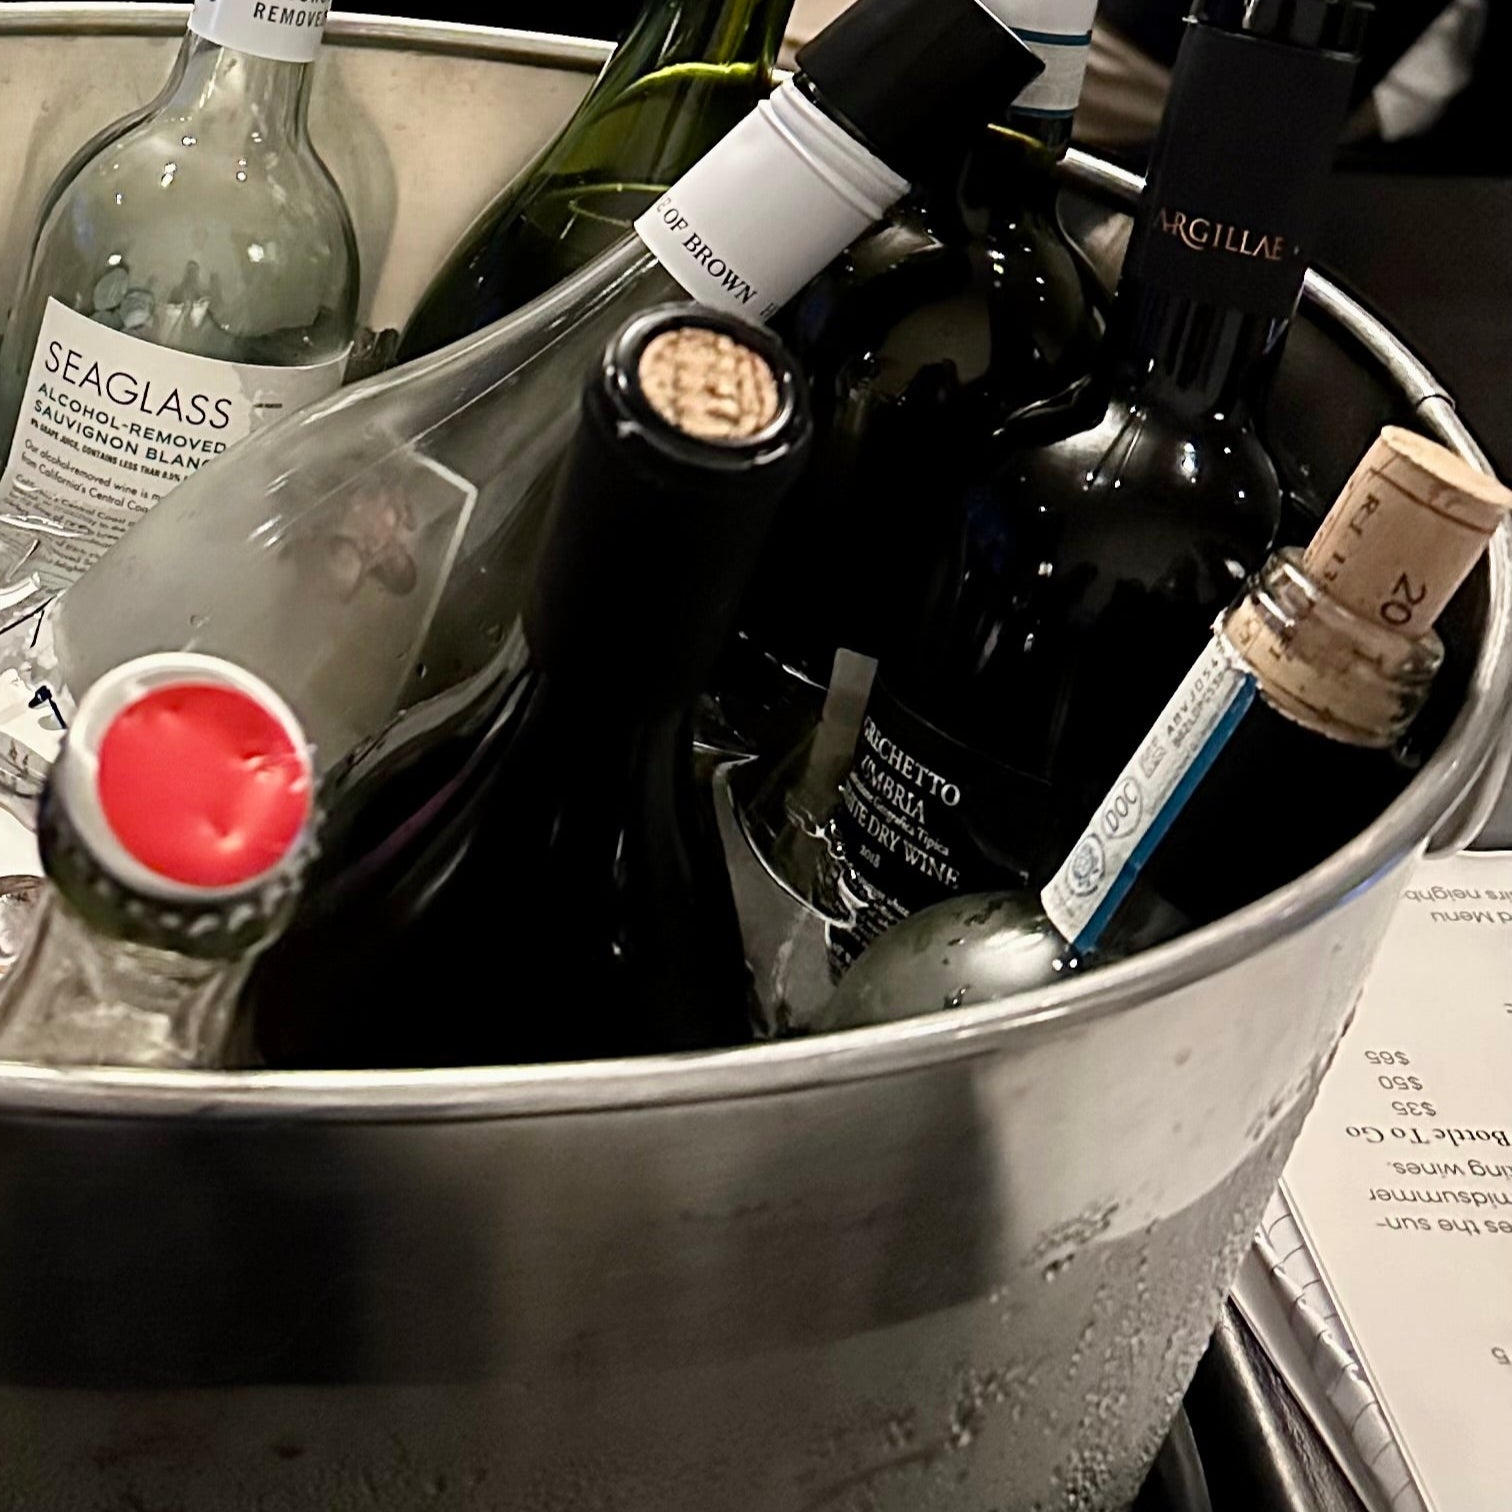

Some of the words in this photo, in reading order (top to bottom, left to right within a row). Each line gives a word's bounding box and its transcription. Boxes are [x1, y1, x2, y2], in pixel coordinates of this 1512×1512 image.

[663, 208, 689, 231] OF
[682, 232, 757, 304] BROWN
[44, 340, 233, 430] SEAGLASS
[34, 399, 138, 456] SAUVIGNON
[38, 382, 227, 455] ALCOHOL-REMOVED
[119, 459, 139, 472] LESS
[140, 465, 161, 478] THAN
[38, 463, 87, 494] California's
[89, 487, 125, 507] Central
[113, 481, 138, 496] wine
[140, 489, 149, 499] is
[1104, 781, 1138, 833] DOC
[917, 826, 950, 857] Tipica
[867, 814, 900, 853] DRY
[902, 839, 960, 890] WINE
[1431, 910, 1495, 924] Menu
[1365, 1050, 1410, 1066] $65
[1377, 1075, 1423, 1091] $50
[1391, 1100, 1437, 1117] $35
[1345, 1125, 1385, 1143] Go
[1390, 1127, 1431, 1144] To
[1431, 1127, 1511, 1147] Bottle
[1386, 1161, 1465, 1179] wines.
[1376, 1215, 1432, 1230] sun-
[1438, 1218, 1481, 1236] the
